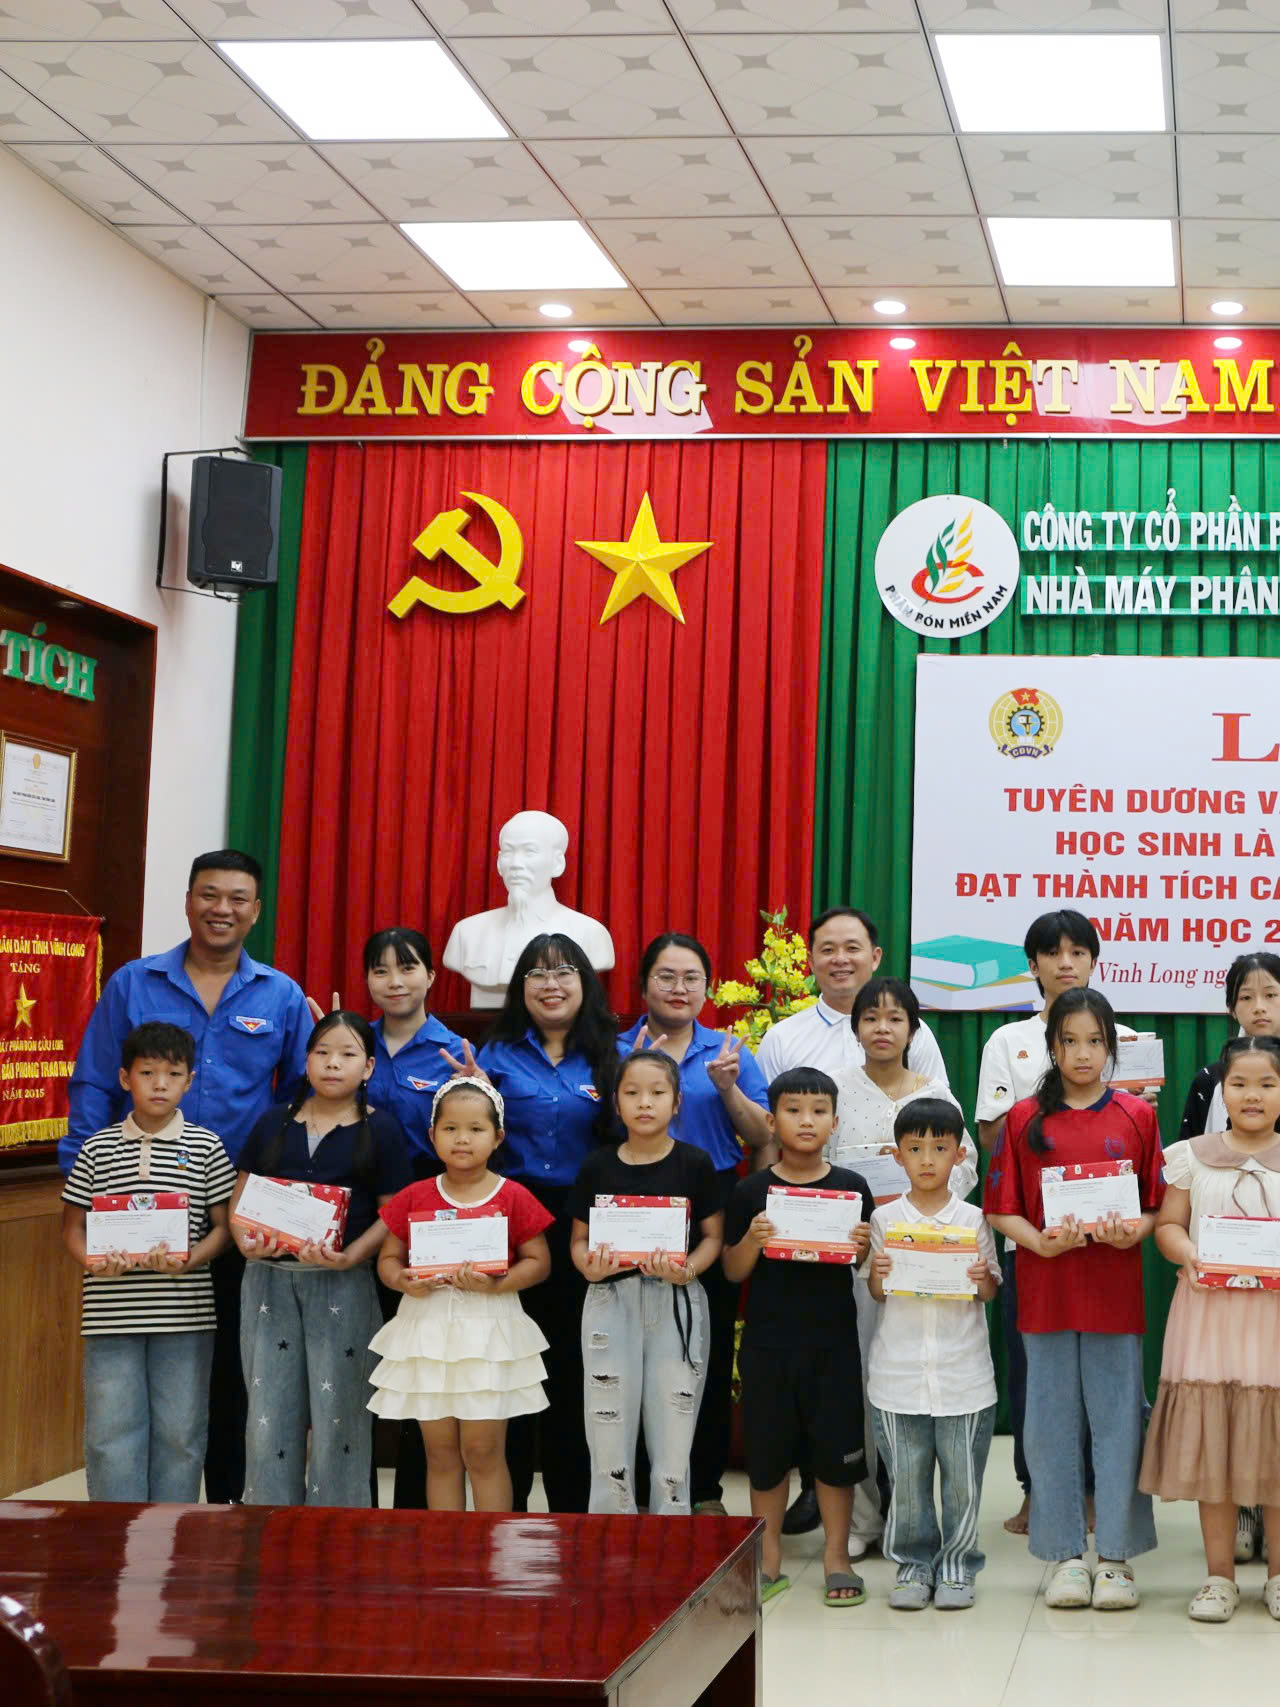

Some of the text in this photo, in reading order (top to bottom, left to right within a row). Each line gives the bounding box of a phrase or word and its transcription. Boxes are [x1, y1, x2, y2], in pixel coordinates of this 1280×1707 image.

[297, 337, 494, 416] ĐẢNG
[520, 345, 708, 429] CỘNG
[734, 335, 880, 414] SẢN
[909, 341, 1080, 427] VIỆT
[1108, 358, 1275, 414] NAM
[1023, 502, 1093, 552] CÔNG
[1101, 511, 1136, 552] TY
[1144, 487, 1181, 552] CỔ
[1190, 494, 1261, 552] PHẦN
[982, 584, 1008, 613] NAM
[1025, 566, 1093, 615] NHÀ
[1104, 566, 1177, 615] MÁY
[1190, 565, 1280, 616] PHÂN
[1004, 784, 1114, 813] TUYÊN
[1126, 787, 1246, 814] DƯƠNG
[1055, 831, 1125, 860] HỌC
[1138, 832, 1222, 857] SINH
[1234, 828, 1276, 857] LÀ
[955, 872, 1022, 903] ĐẠT
[1033, 868, 1149, 899] THÀNH
[1160, 870, 1237, 900] TÍCH
[1088, 912, 1169, 942] NĂM
[1182, 918, 1252, 948] HỌC
[1099, 961, 1142, 984] Vĩnh
[1148, 962, 1199, 989] Long
[24, 1088, 46, 1099] 2015
